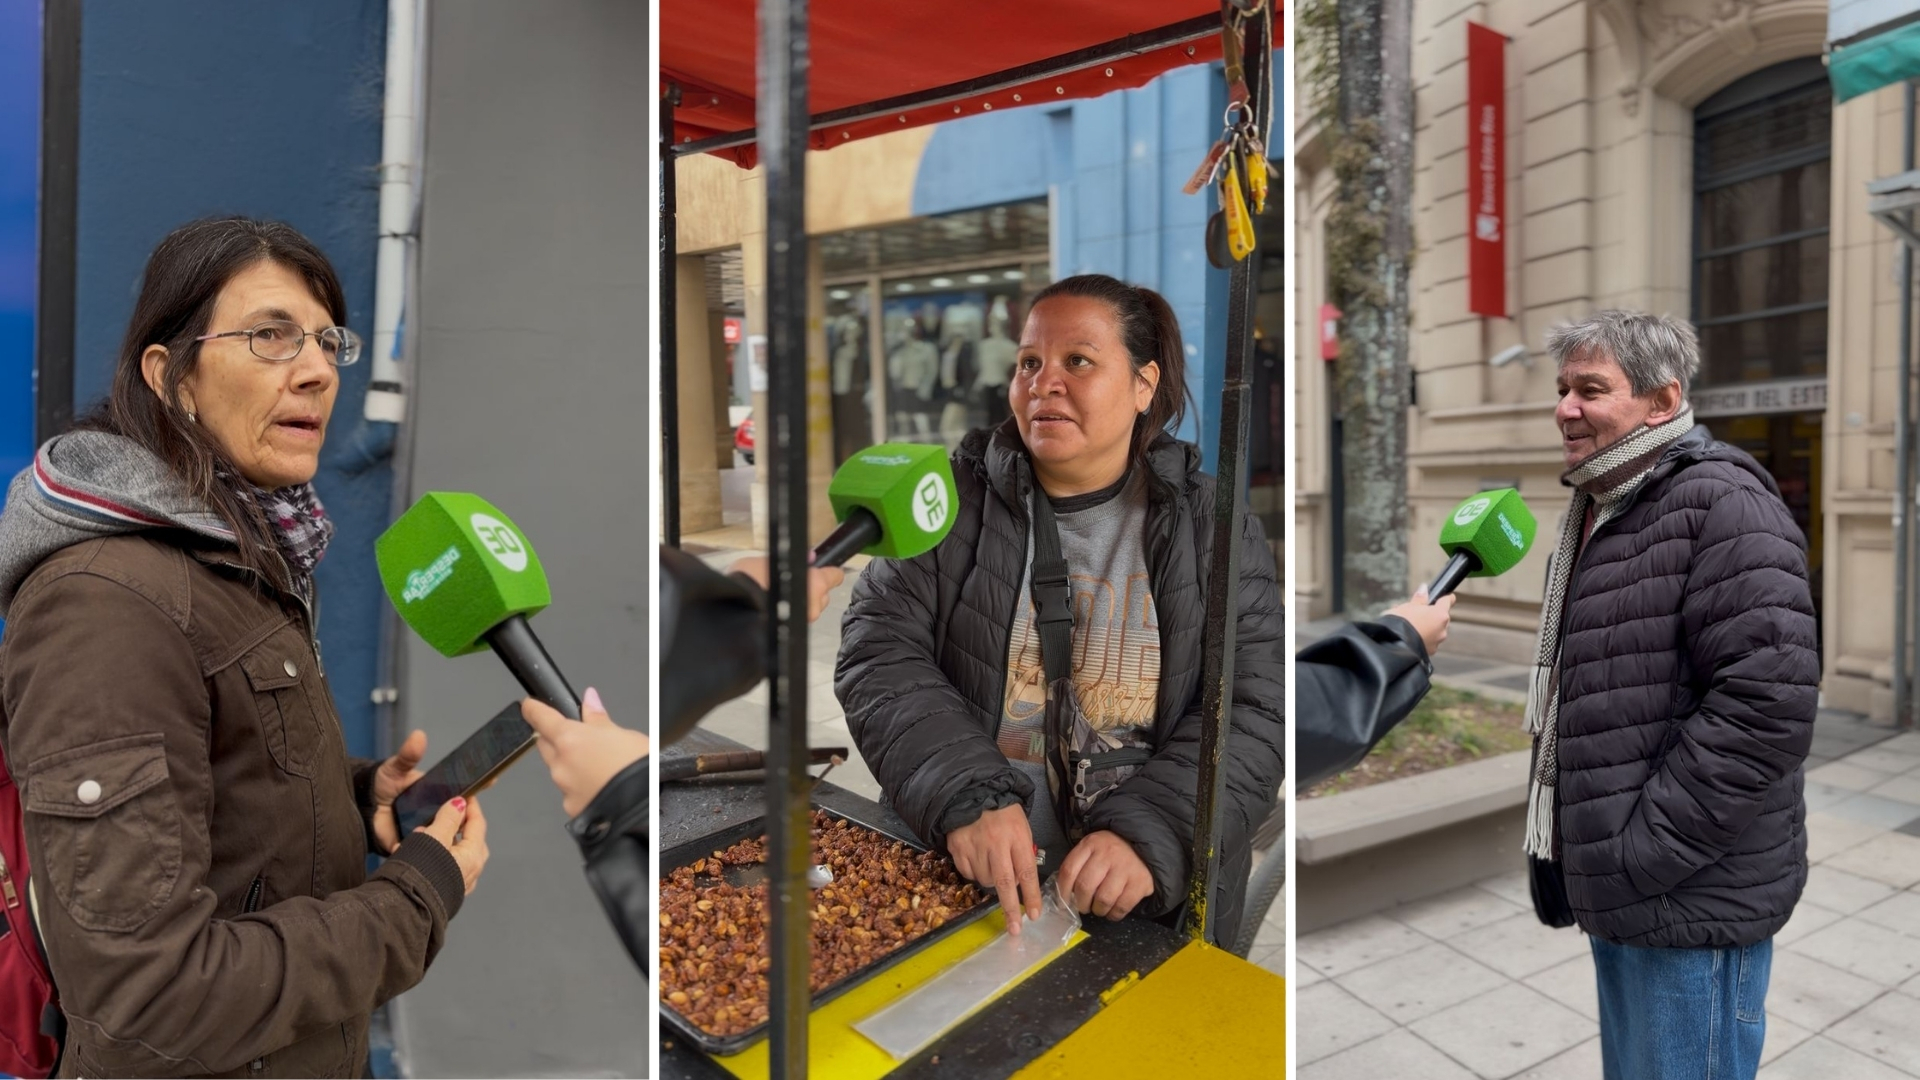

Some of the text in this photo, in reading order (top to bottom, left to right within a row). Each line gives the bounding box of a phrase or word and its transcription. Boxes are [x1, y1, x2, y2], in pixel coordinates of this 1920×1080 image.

[1755, 388, 1782, 407] DEL
[921, 480, 945, 527] DE
[1457, 502, 1488, 518] DE
